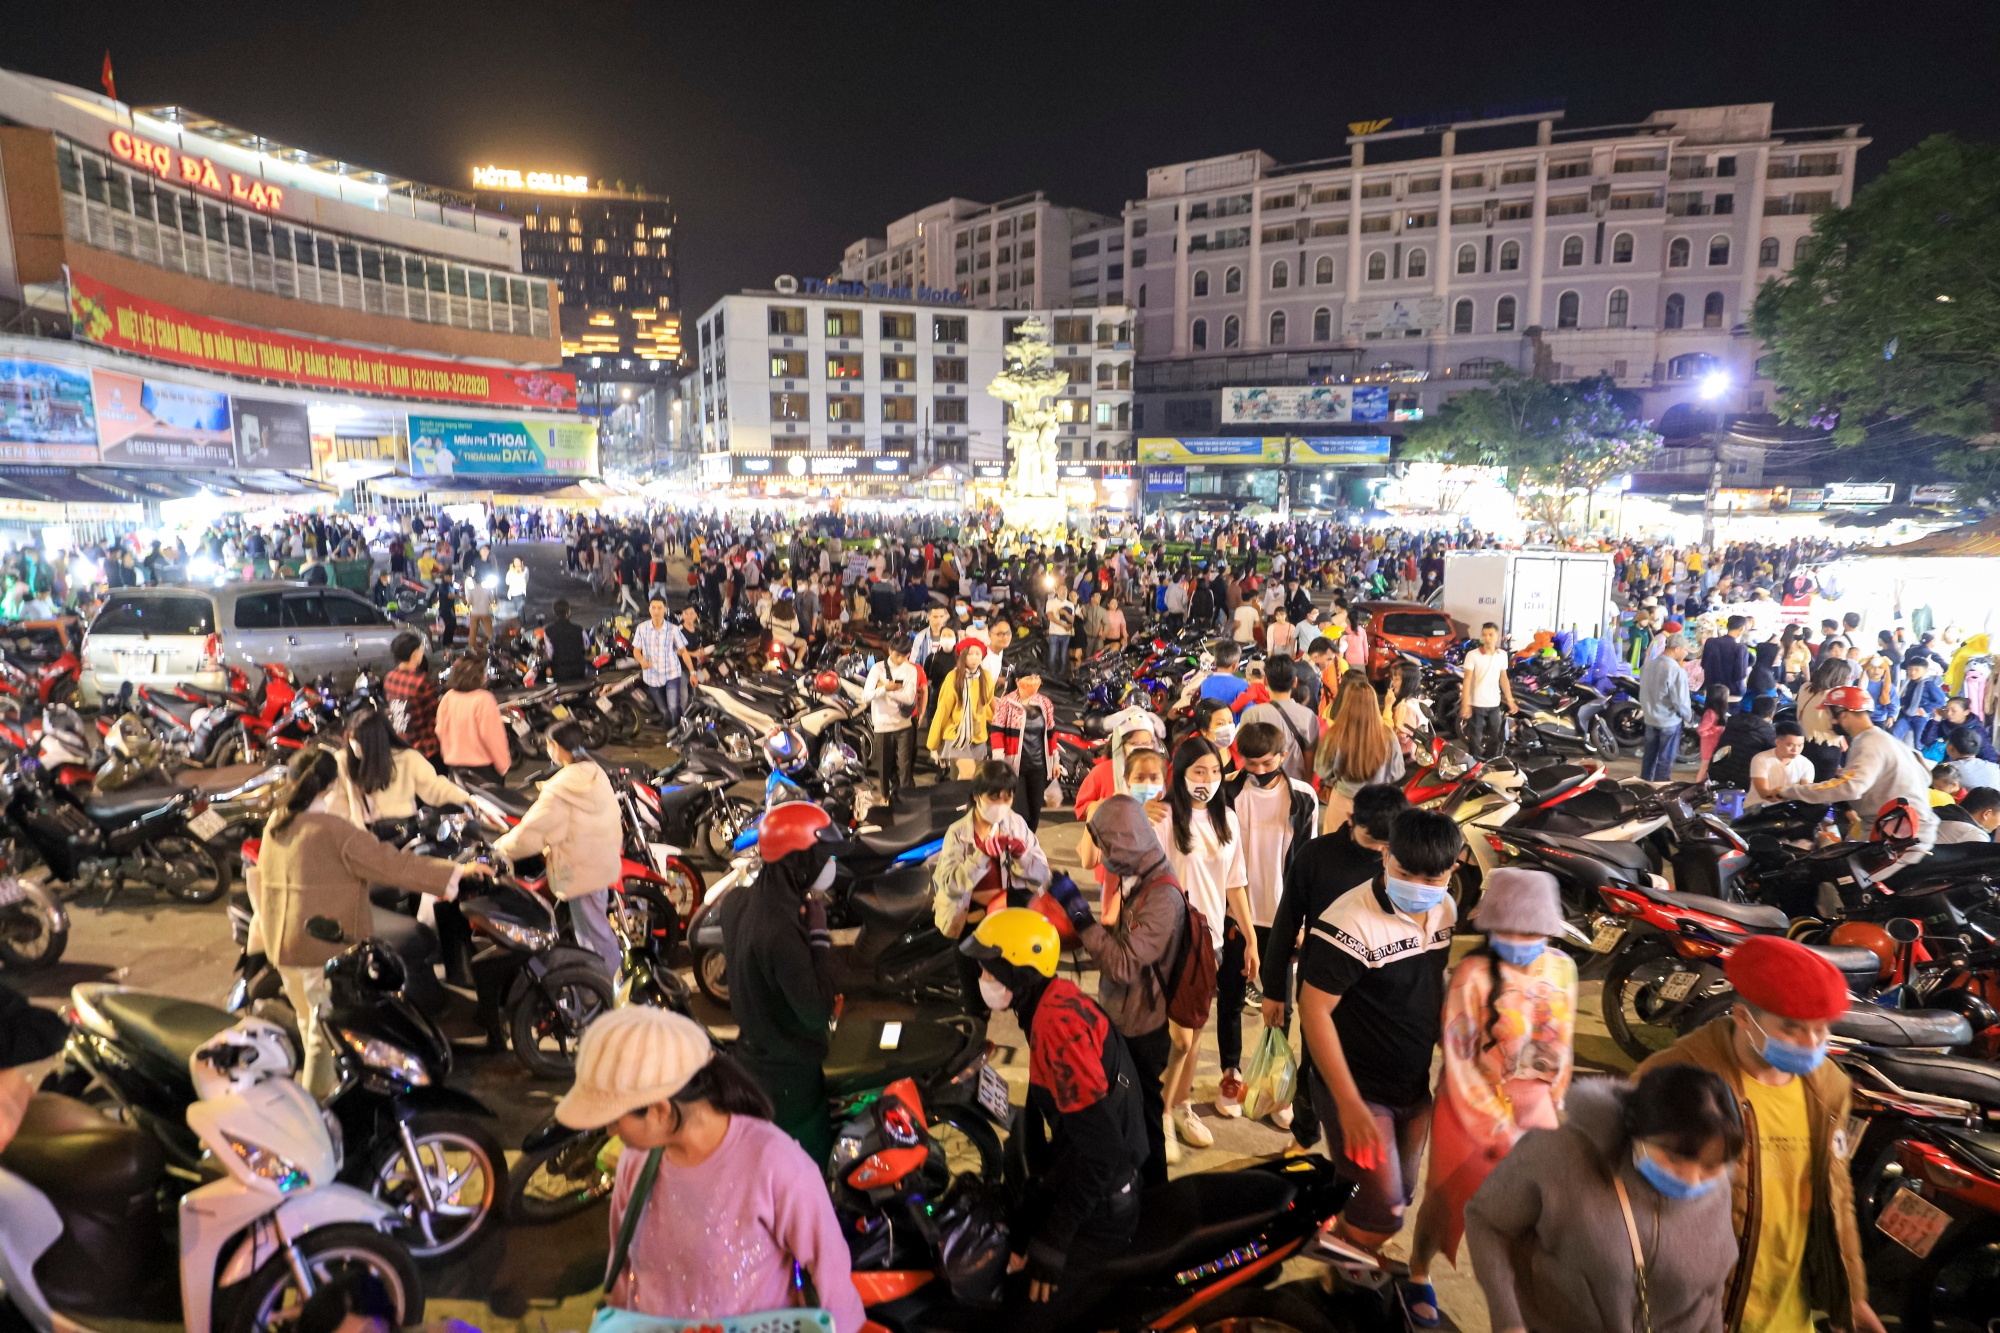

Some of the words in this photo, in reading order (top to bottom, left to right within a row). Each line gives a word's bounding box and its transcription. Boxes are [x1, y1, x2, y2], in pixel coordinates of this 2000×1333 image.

[110, 130, 171, 179] CHỢ
[179, 155, 222, 192] ĐÀ
[229, 172, 282, 210] LẠT
[802, 277, 865, 295] Thanh
[117, 304, 139, 347] NHIỆT
[139, 310, 155, 352] LIỆT
[156, 315, 177, 351] CHÀO
[235, 336, 257, 367] NGÀY
[258, 340, 286, 372] THÀNH
[287, 344, 302, 378] LẬP
[304, 345, 328, 378] ĐẢNG
[329, 352, 352, 385] CỘNG
[353, 353, 370, 384] SẢN
[371, 358, 389, 390] VIỆT
[390, 365, 409, 388] NAM
[502, 448, 538, 463] DATA
[1175, 473, 1183, 484] XE
